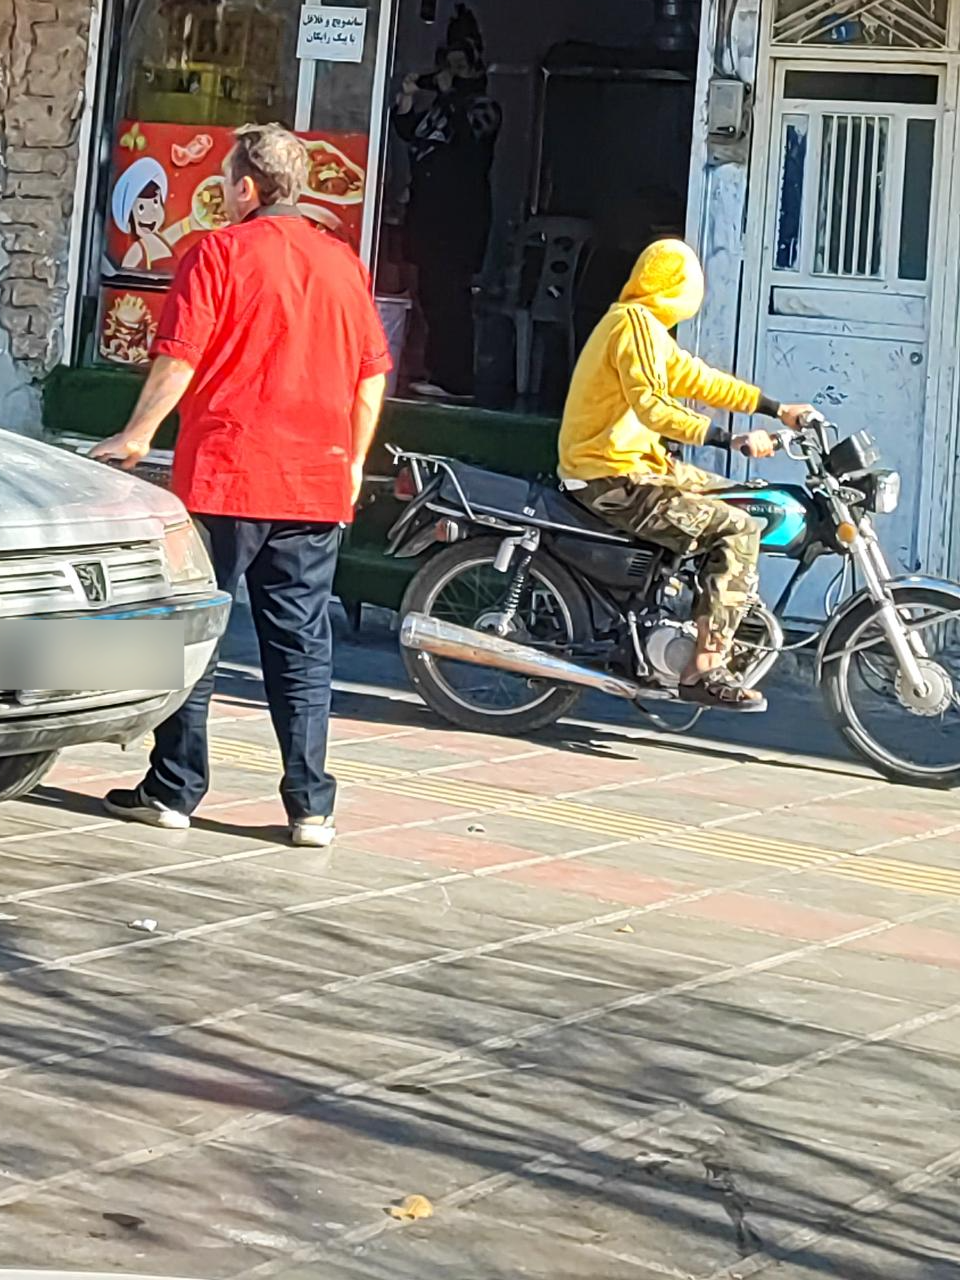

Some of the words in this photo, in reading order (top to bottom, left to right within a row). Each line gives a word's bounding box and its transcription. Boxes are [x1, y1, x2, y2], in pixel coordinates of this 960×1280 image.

[302, 14, 324, 26] فلافل
[324, 18, 330, 28] و
[331, 16, 363, 28] ساندویچ
[306, 31, 331, 44] رایگان
